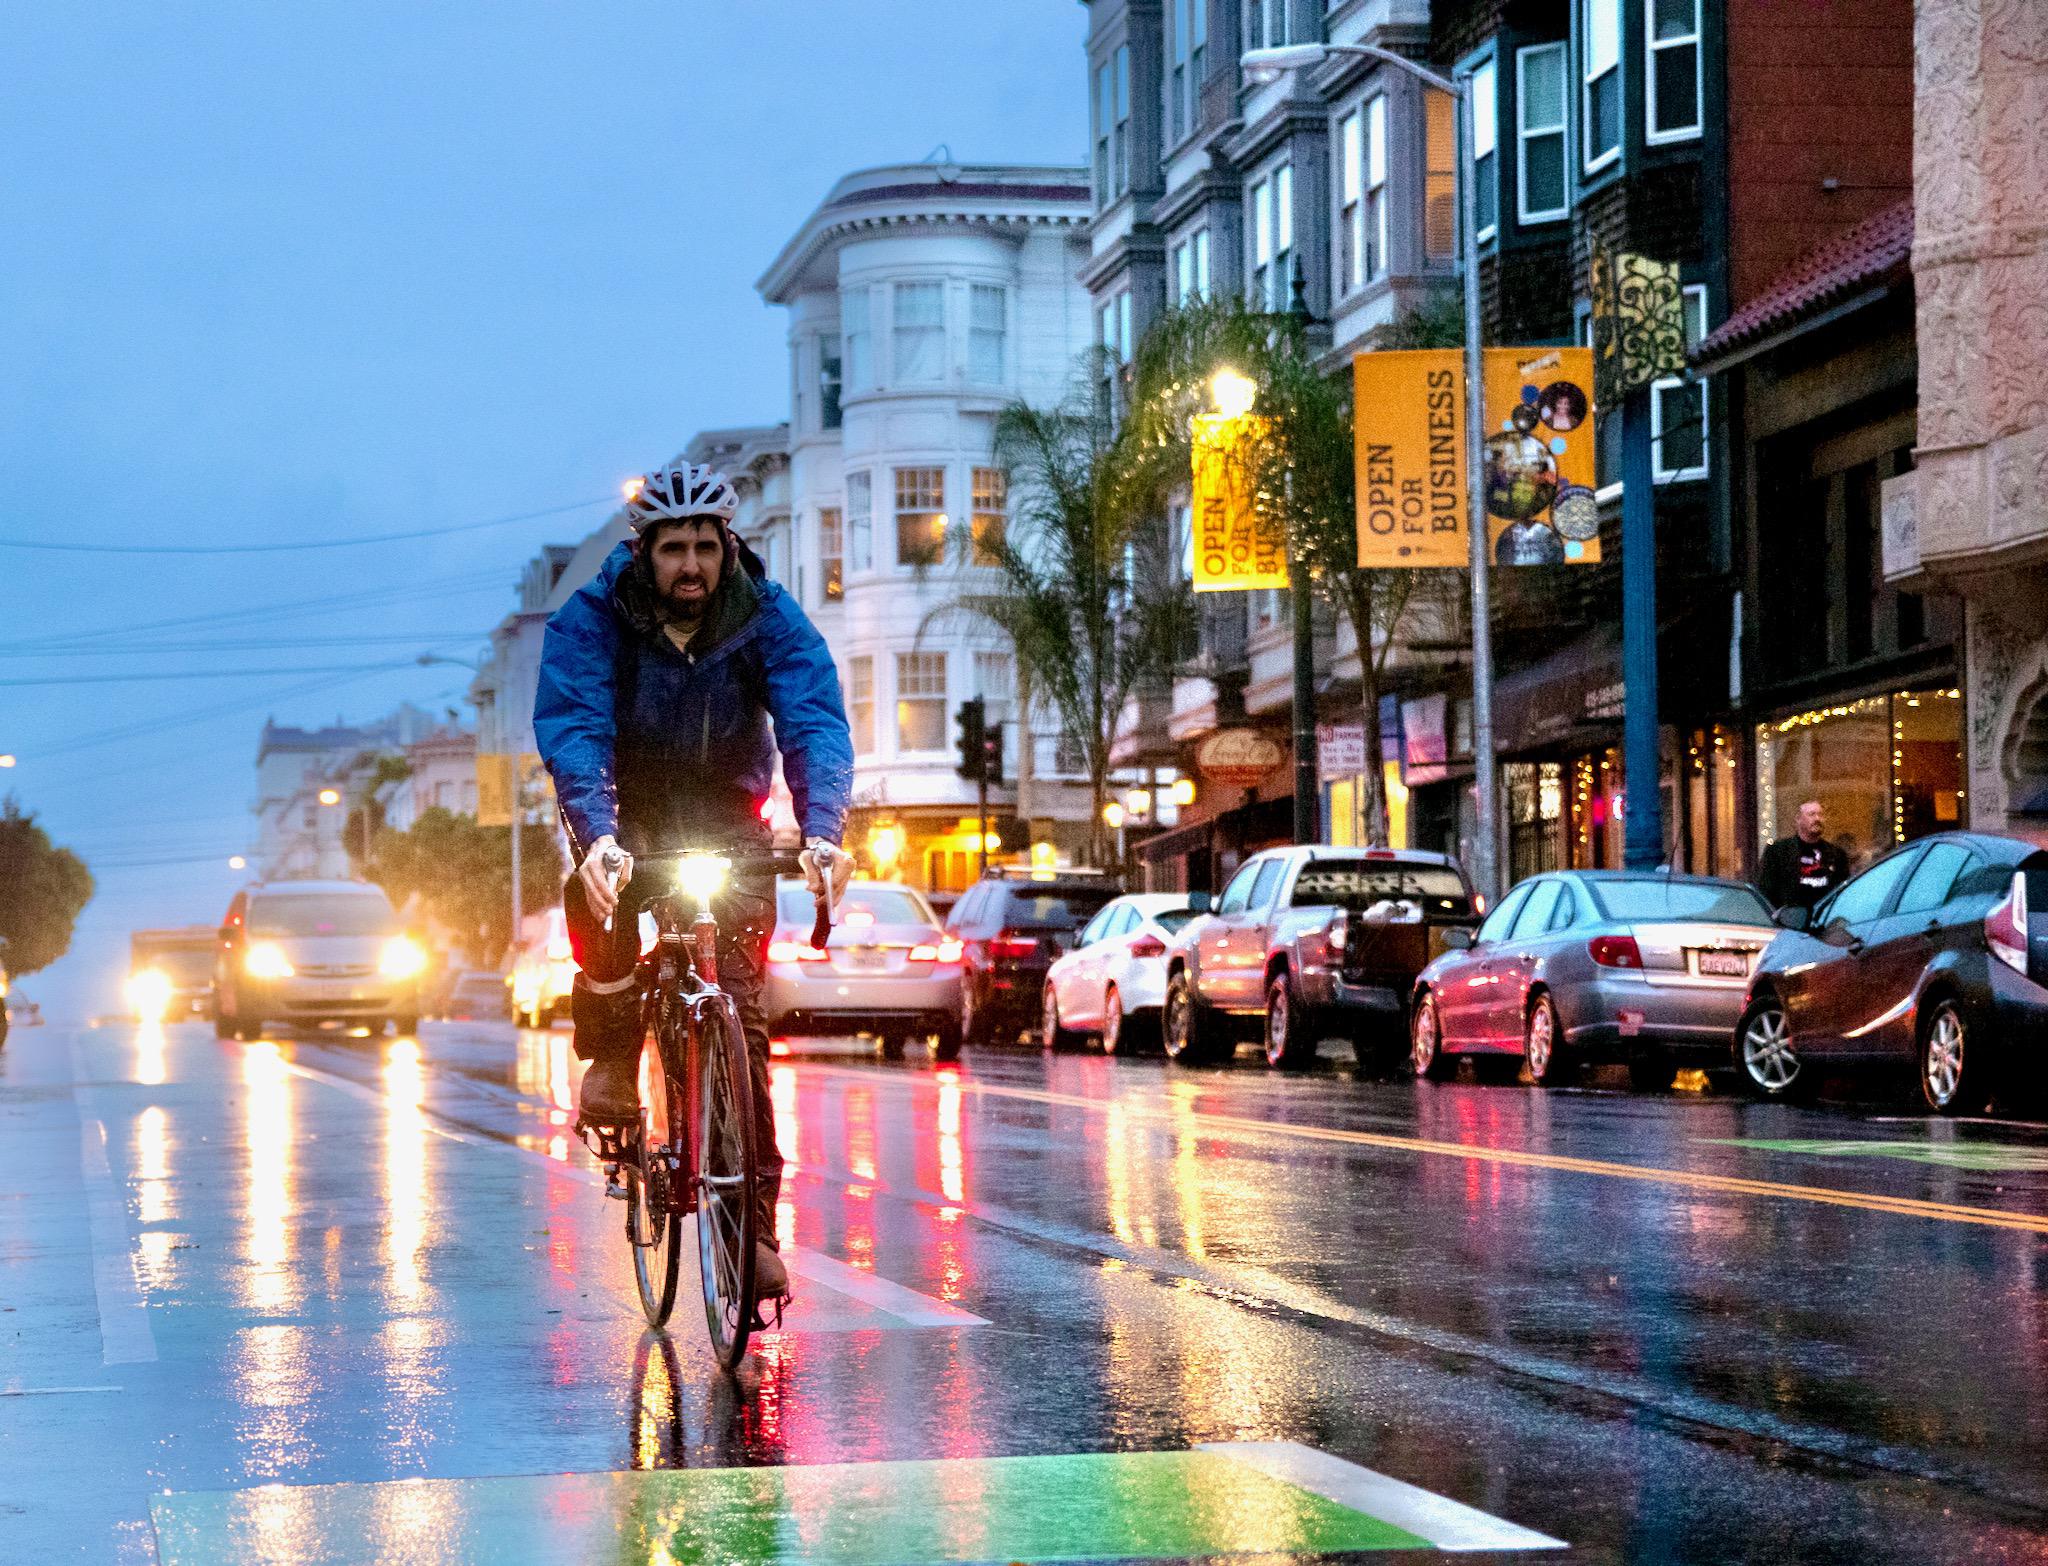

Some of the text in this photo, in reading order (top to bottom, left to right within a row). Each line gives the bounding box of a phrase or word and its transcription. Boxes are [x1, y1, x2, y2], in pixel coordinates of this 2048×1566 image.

[1367, 442, 1395, 536] OPEN
[1427, 369, 1458, 534] BUSINESS
[1203, 498, 1226, 576] OPEN
[1401, 476, 1424, 535] FOR
[1232, 528, 1249, 575] FOR
